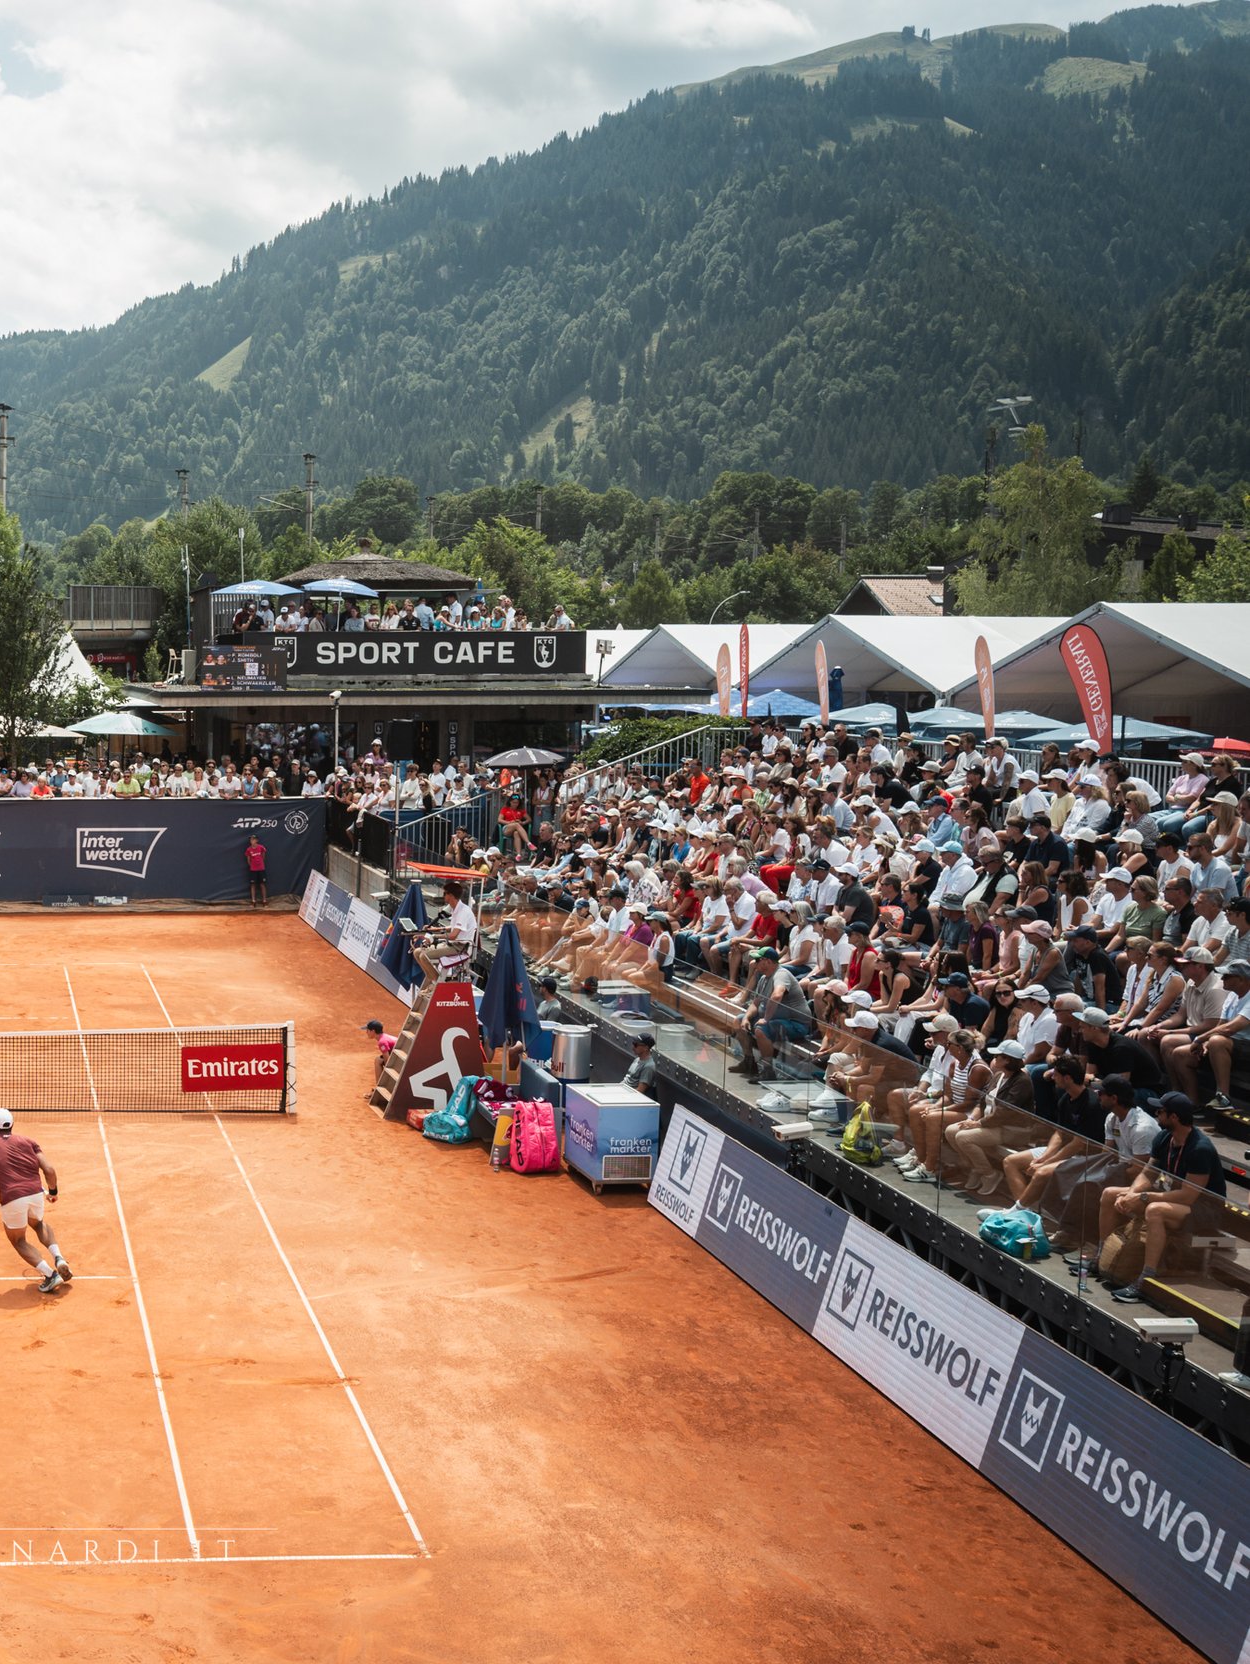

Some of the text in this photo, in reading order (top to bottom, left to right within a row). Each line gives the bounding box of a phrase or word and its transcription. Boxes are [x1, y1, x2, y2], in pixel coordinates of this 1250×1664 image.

[316, 641, 515, 664] SPORT CAFE
[231, 817, 278, 828] ATP 250
[82, 831, 124, 848] inter
[85, 849, 143, 861] wetten
[187, 1057, 279, 1078] Emirates
[449, 1084, 467, 1116] EAD
[570, 1115, 594, 1138] franken
[570, 1129, 595, 1152] markter
[610, 1137, 652, 1146] franken
[610, 1146, 652, 1154] markter
[654, 1184, 695, 1224] REISSWOLF
[734, 1194, 832, 1284] REISSWOLF
[866, 1288, 1001, 1406] REISSWOLF
[1056, 1422, 1250, 1591] REISSWOLF
